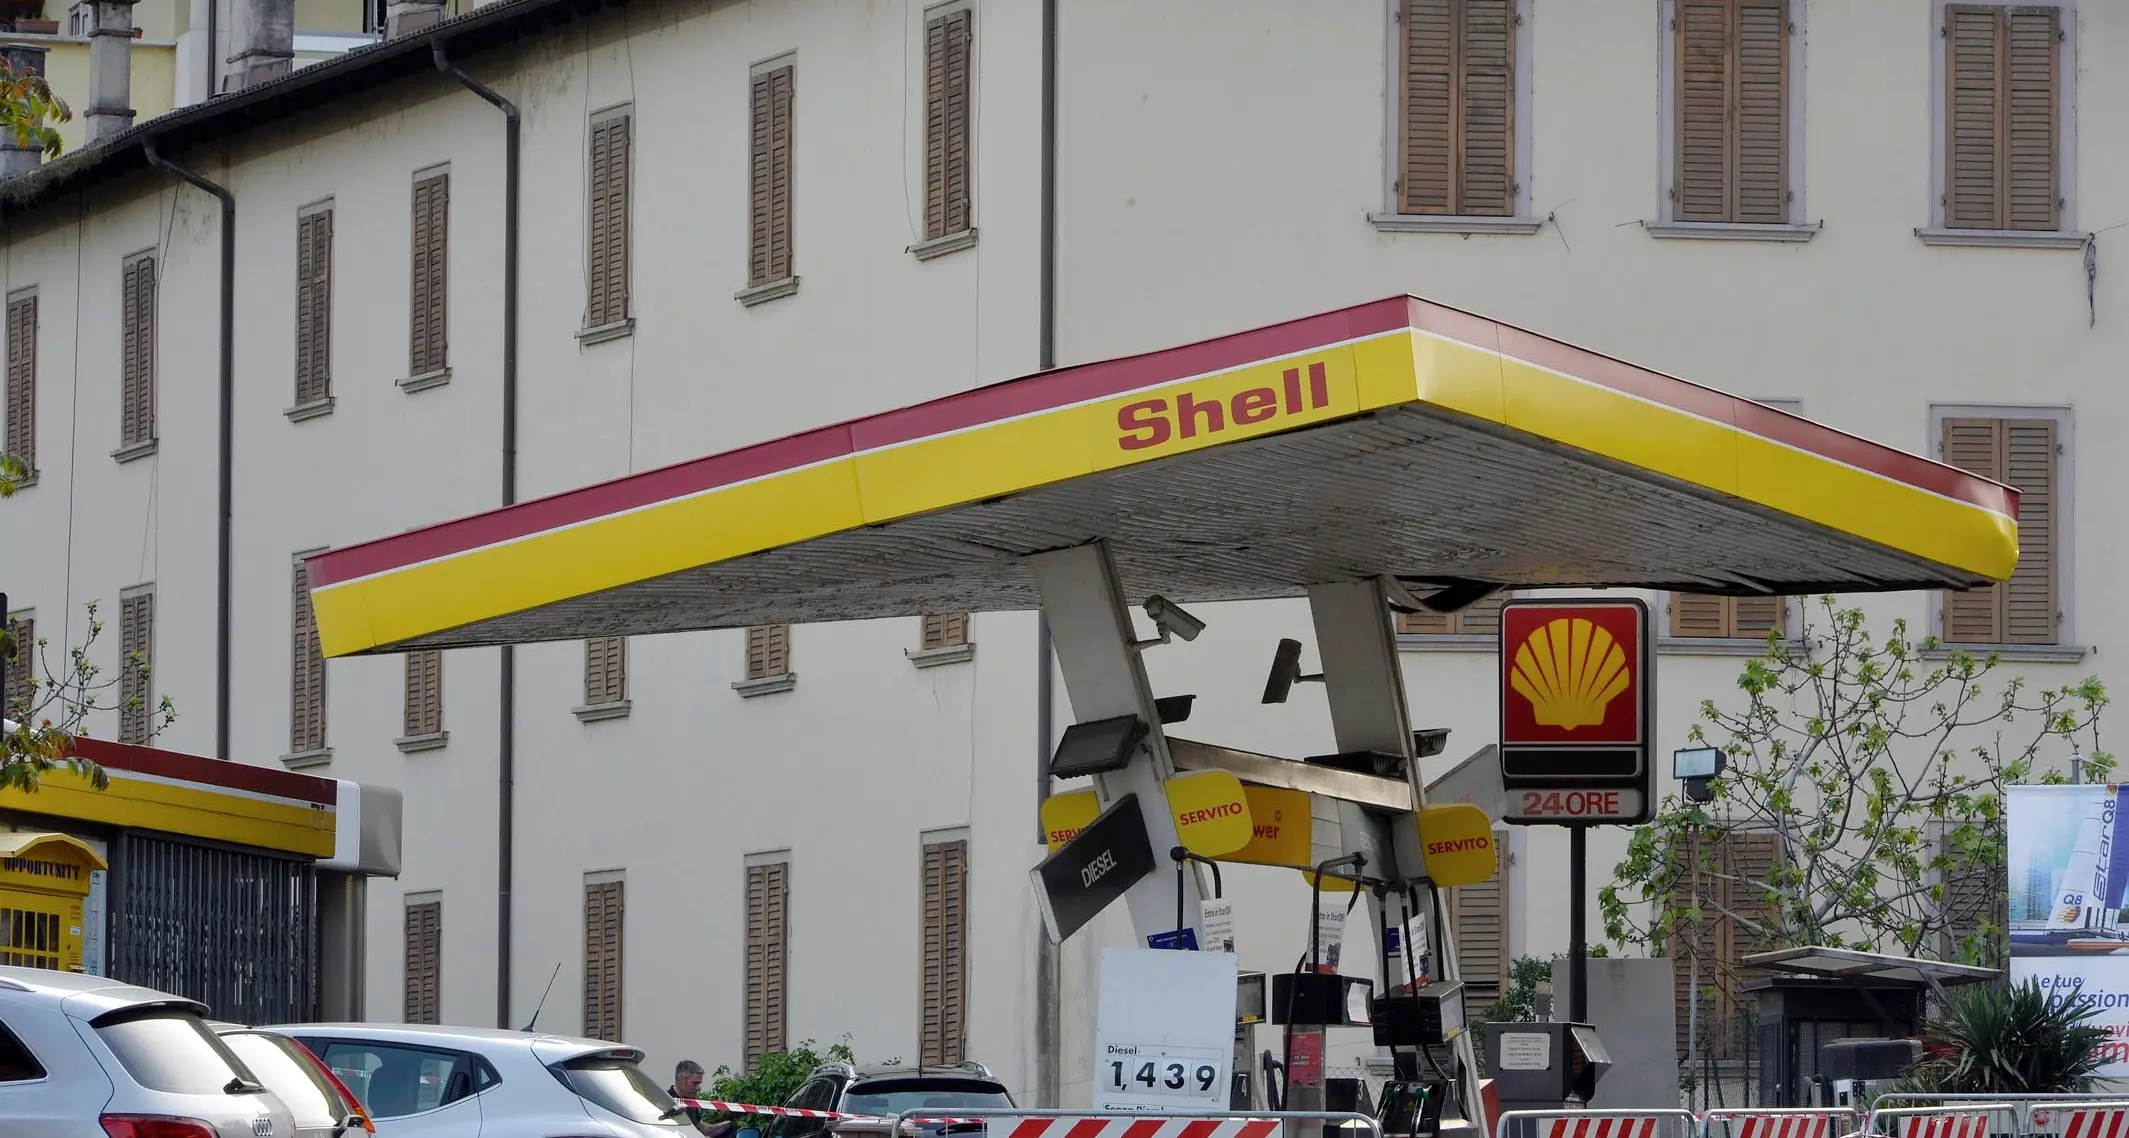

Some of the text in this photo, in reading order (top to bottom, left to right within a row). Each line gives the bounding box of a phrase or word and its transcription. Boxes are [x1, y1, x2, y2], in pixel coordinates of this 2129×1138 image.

[1117, 361, 1329, 451] Shell
[1180, 802, 1242, 826] SERVITO
[1428, 837, 1488, 855] SERVITO
[4, 857, 80, 880] OPPORTUNITY
[1080, 849, 1117, 888] DIESEL
[2063, 893, 2083, 905] Q8
[2055, 974, 2082, 988] tue
[1107, 1045, 1137, 1055] Diesel
[1110, 1061, 1216, 1091] 1,439
